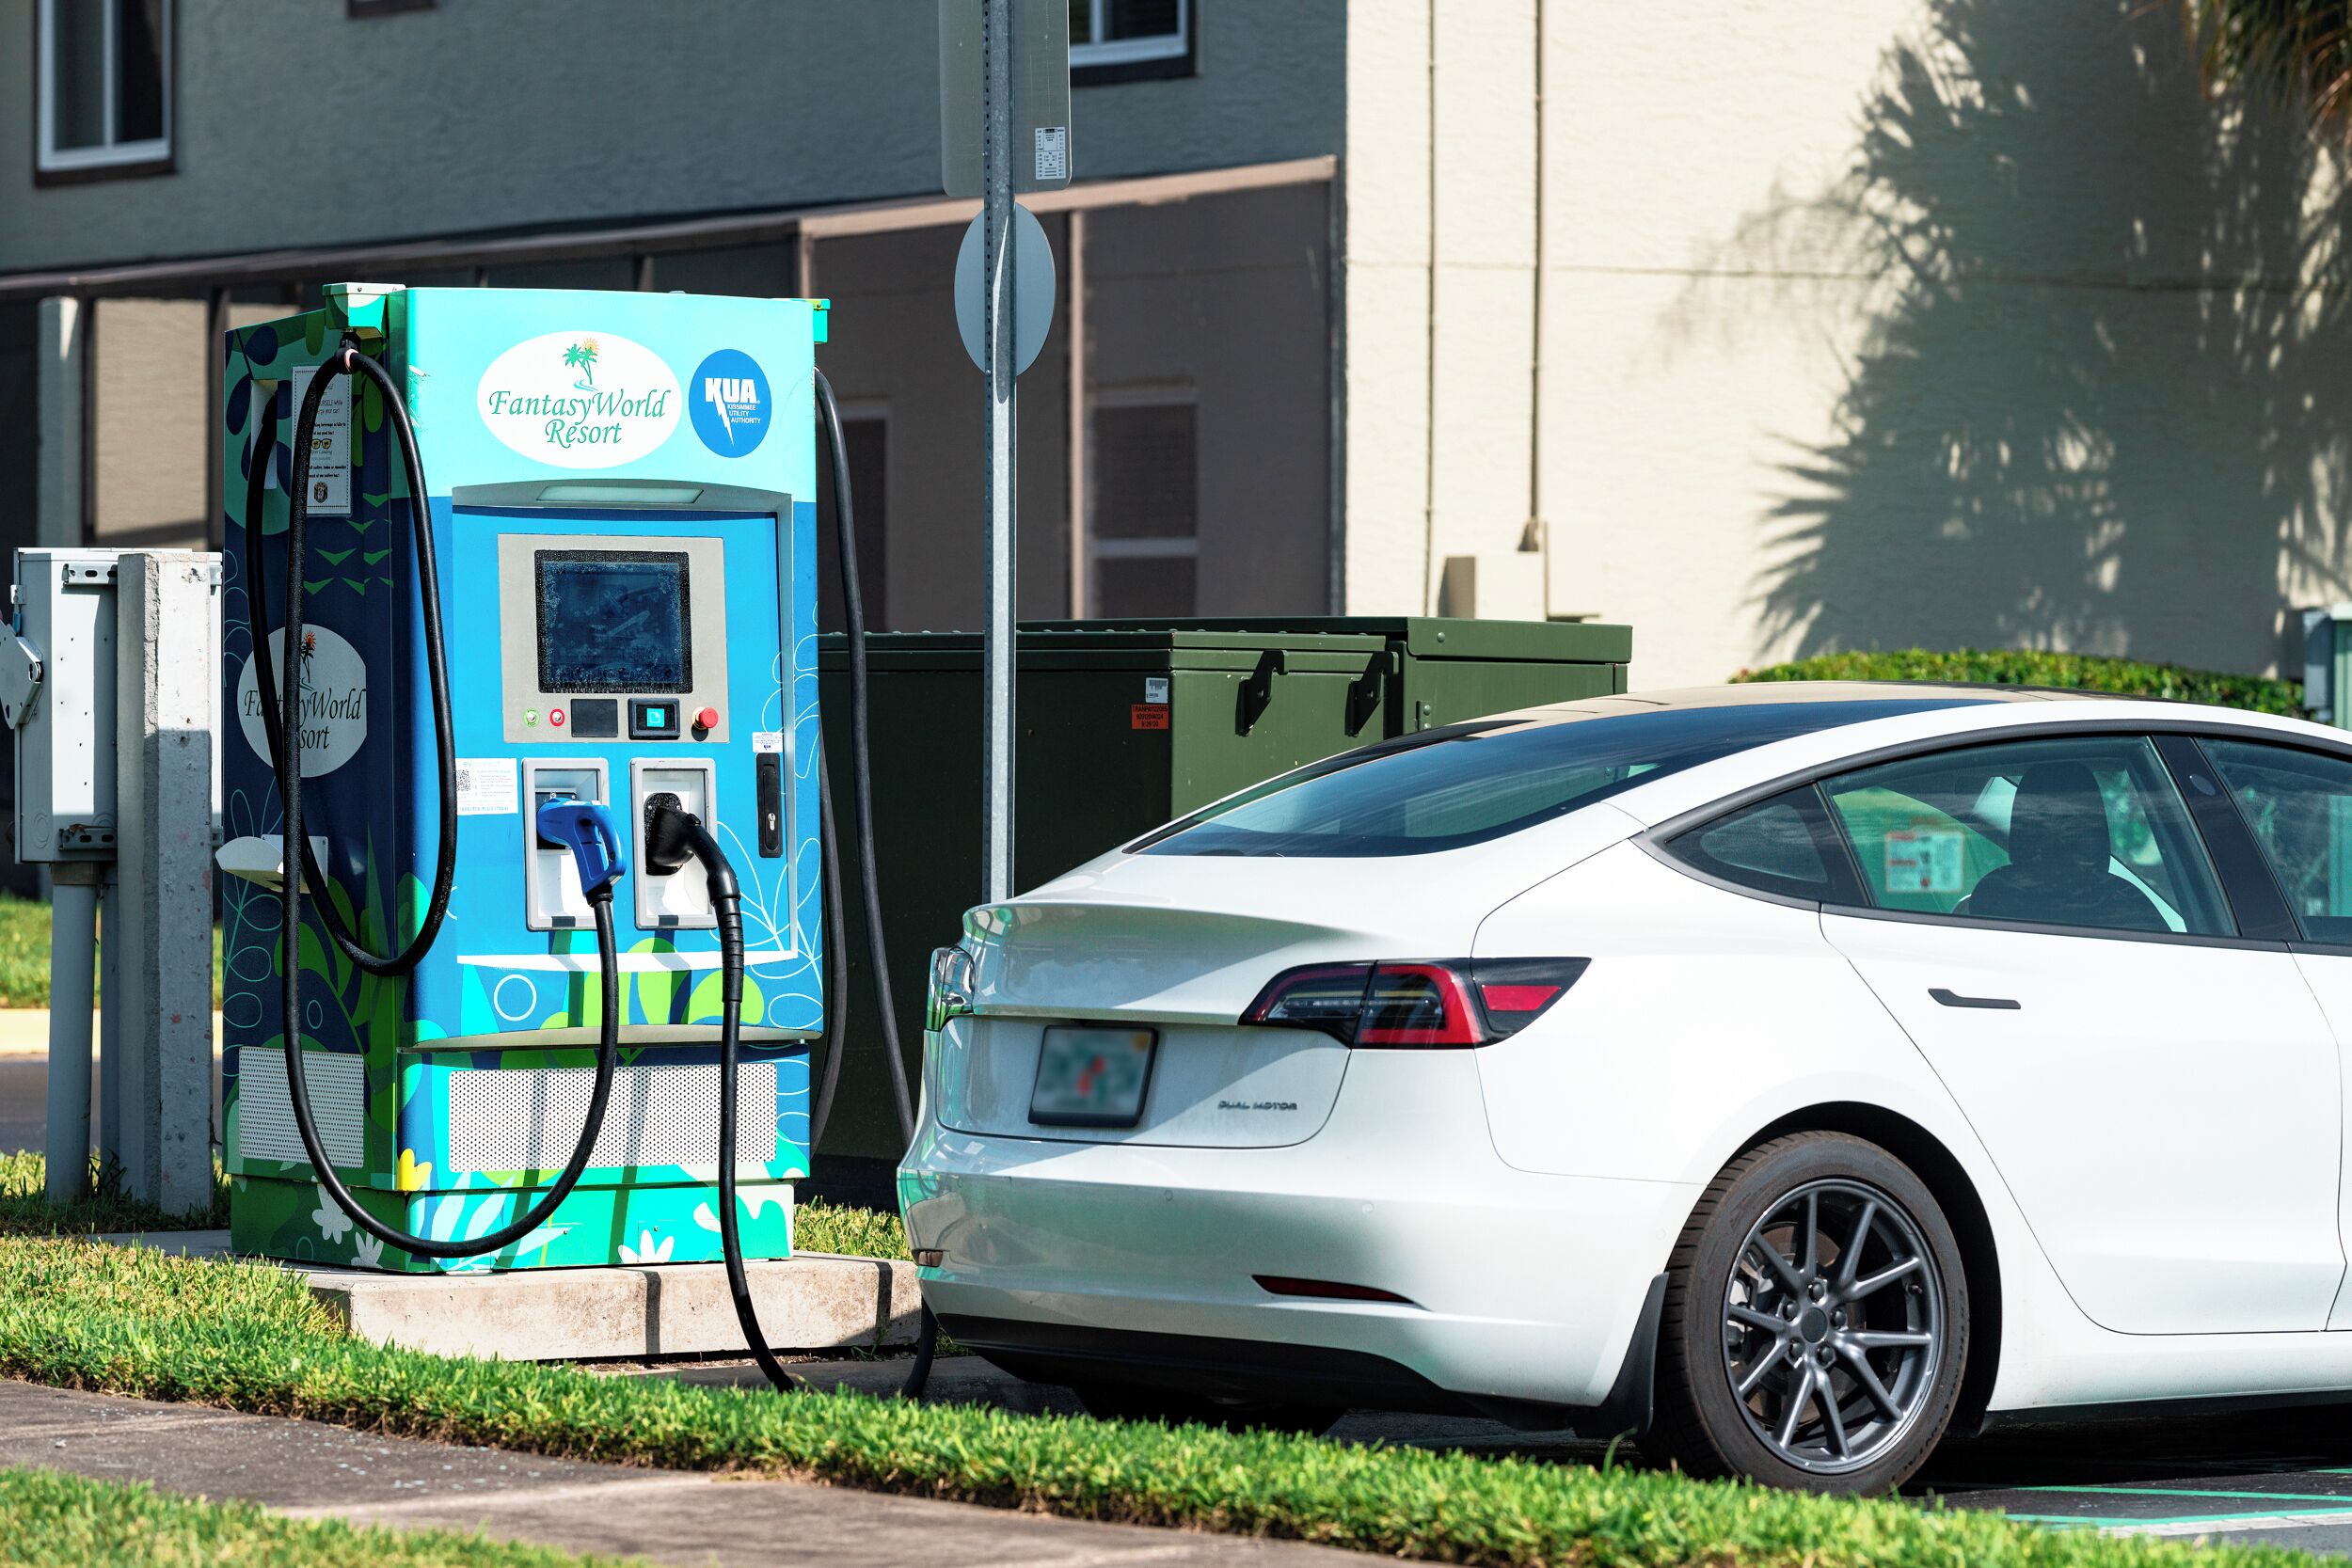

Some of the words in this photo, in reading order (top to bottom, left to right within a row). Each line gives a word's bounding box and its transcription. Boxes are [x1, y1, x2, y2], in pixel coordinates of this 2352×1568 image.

[704, 377, 758, 404] KUA
[488, 388, 672, 424] FantasyWorld
[545, 419, 623, 449] Resort
